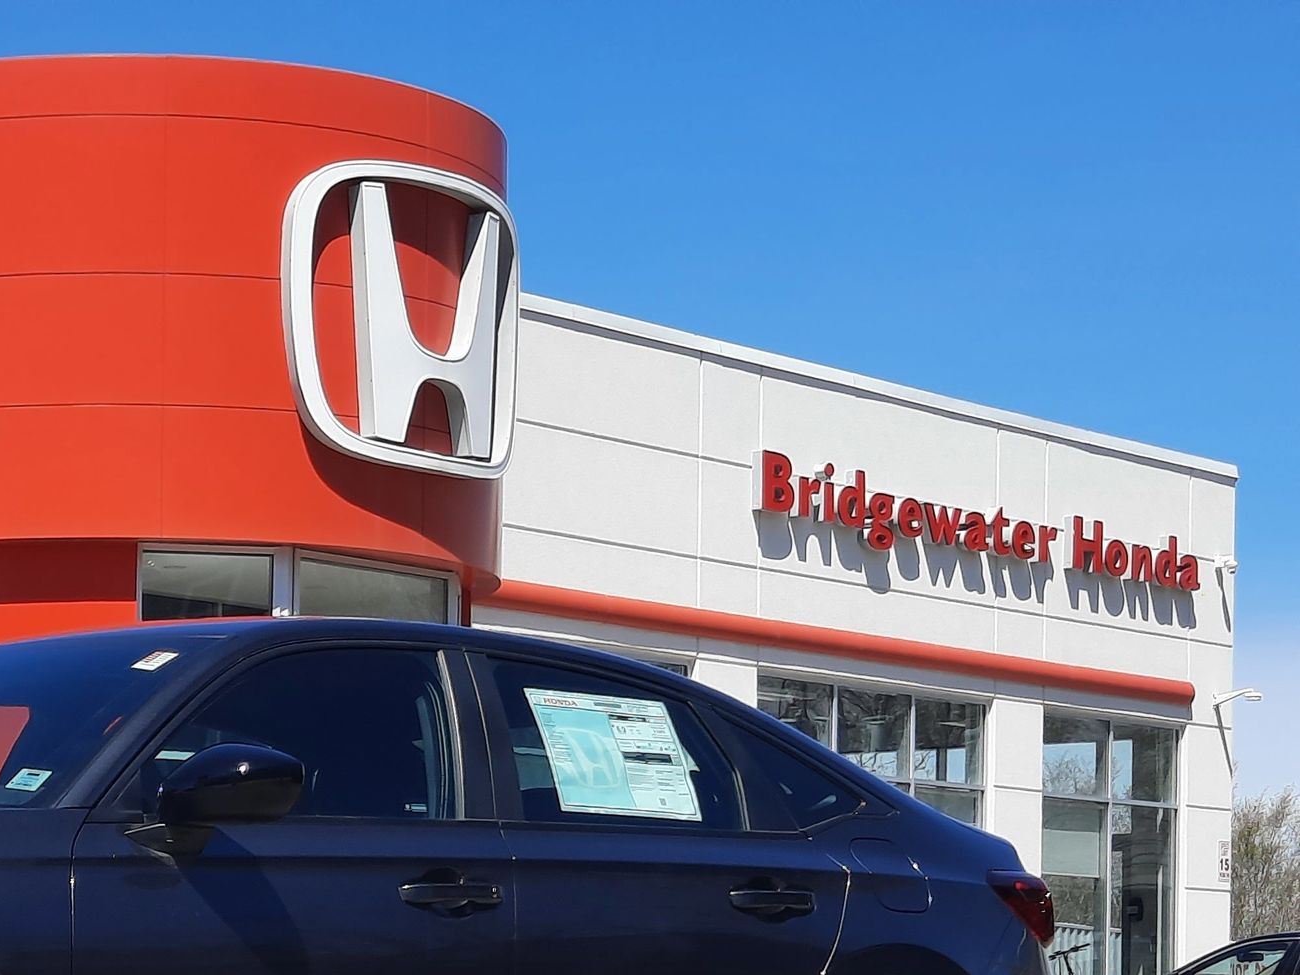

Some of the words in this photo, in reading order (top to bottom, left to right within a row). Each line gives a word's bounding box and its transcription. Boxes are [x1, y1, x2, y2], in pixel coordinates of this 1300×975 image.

[762, 449, 1057, 562] Bridgewater
[1073, 515, 1200, 592] Honda
[543, 697, 578, 707] HONDA
